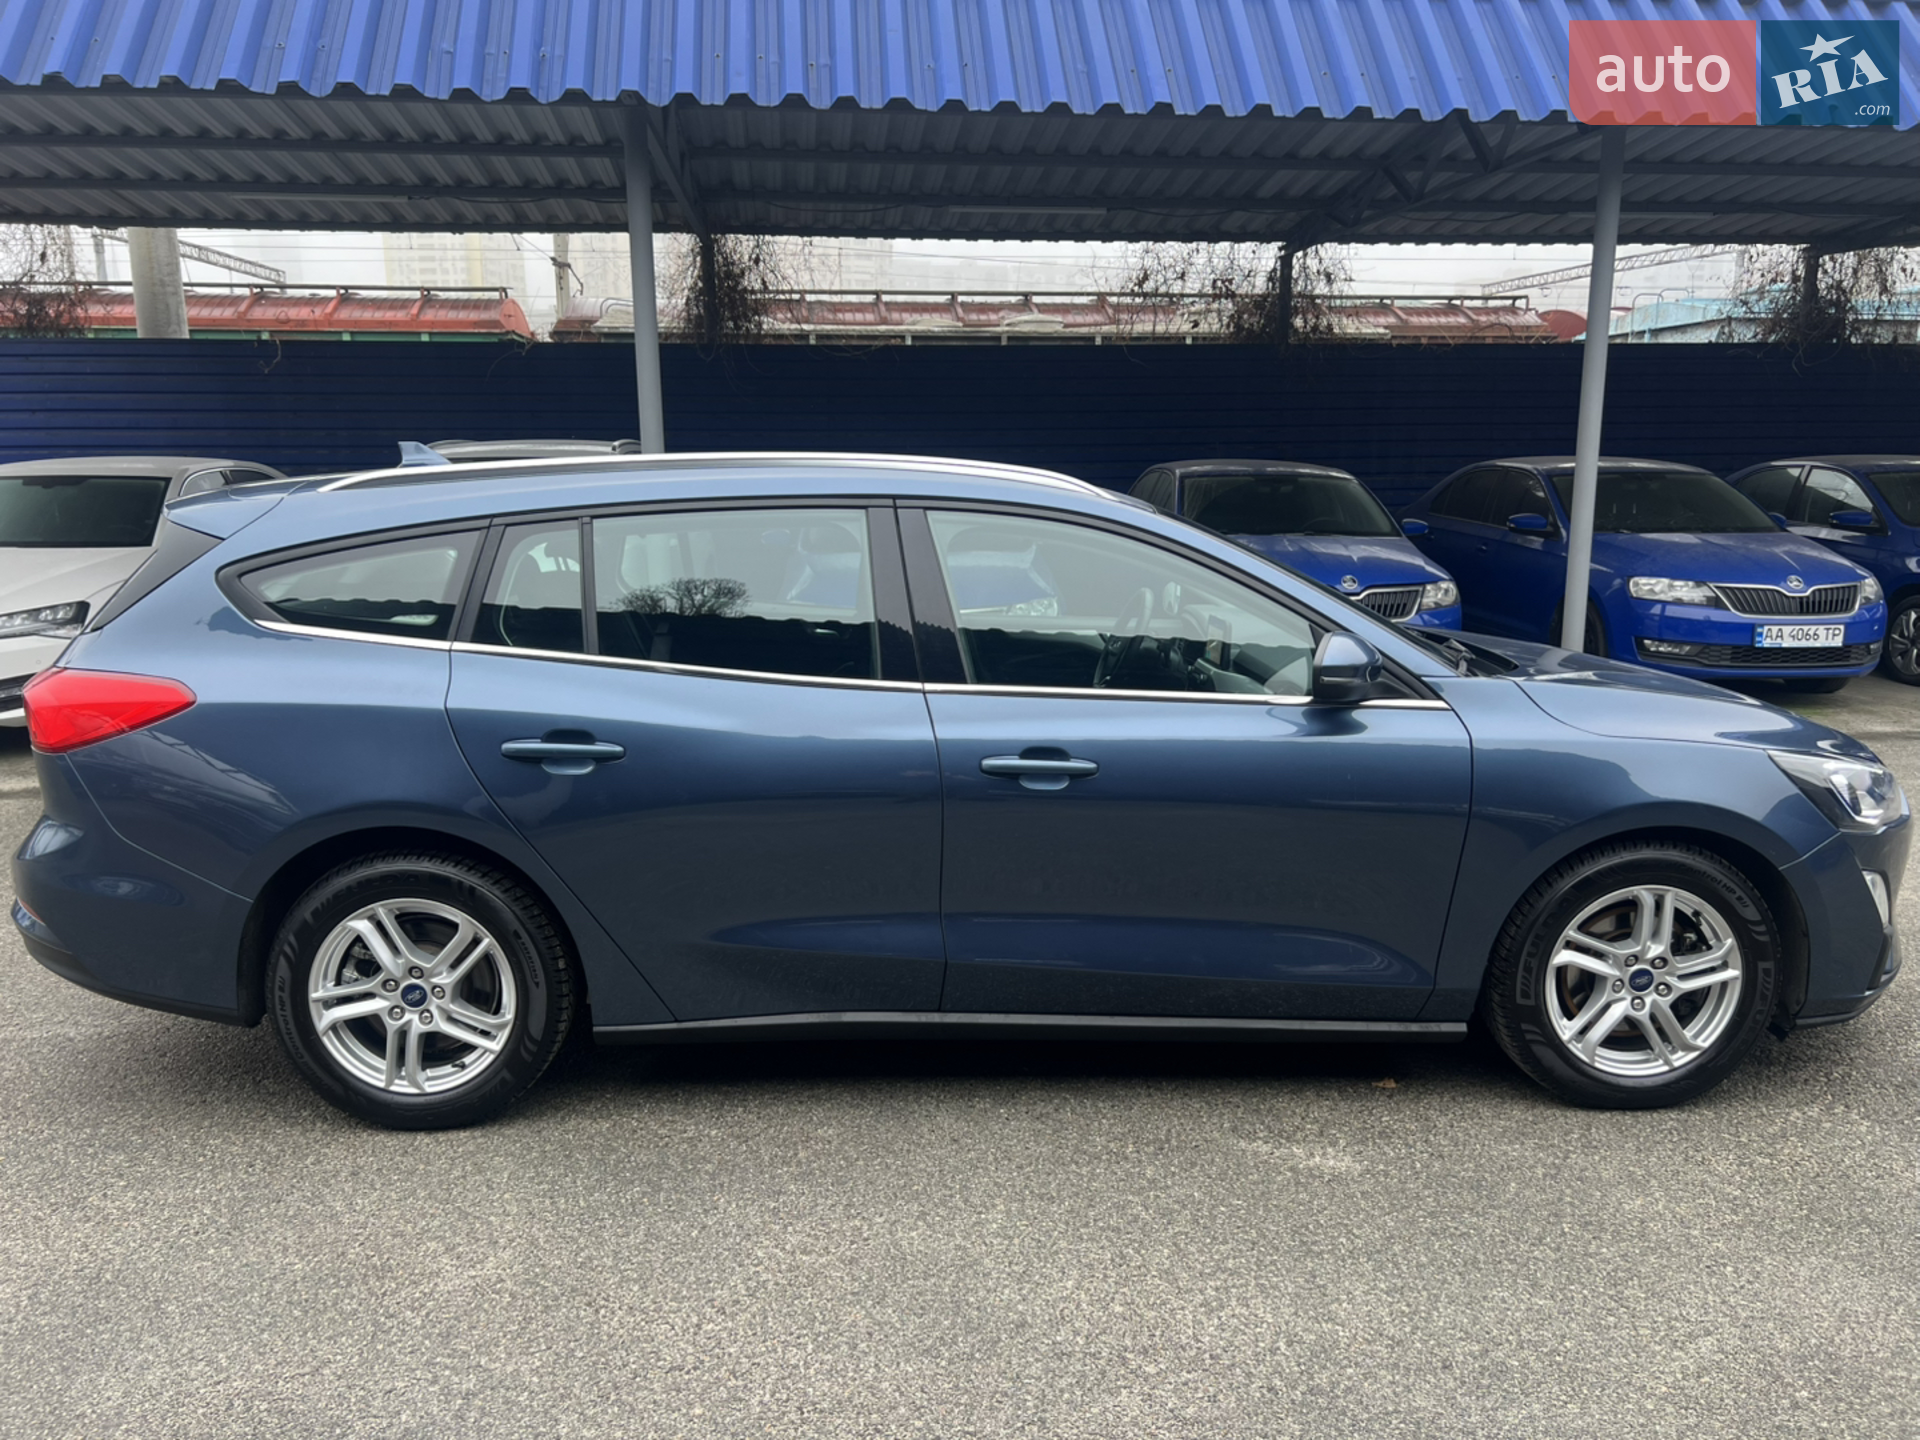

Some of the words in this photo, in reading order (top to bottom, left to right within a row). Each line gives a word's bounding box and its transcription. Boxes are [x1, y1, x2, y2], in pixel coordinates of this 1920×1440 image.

[1764, 627, 1784, 641] AA
[1788, 627, 1820, 641] 4066
[1823, 627, 1842, 641] TP
